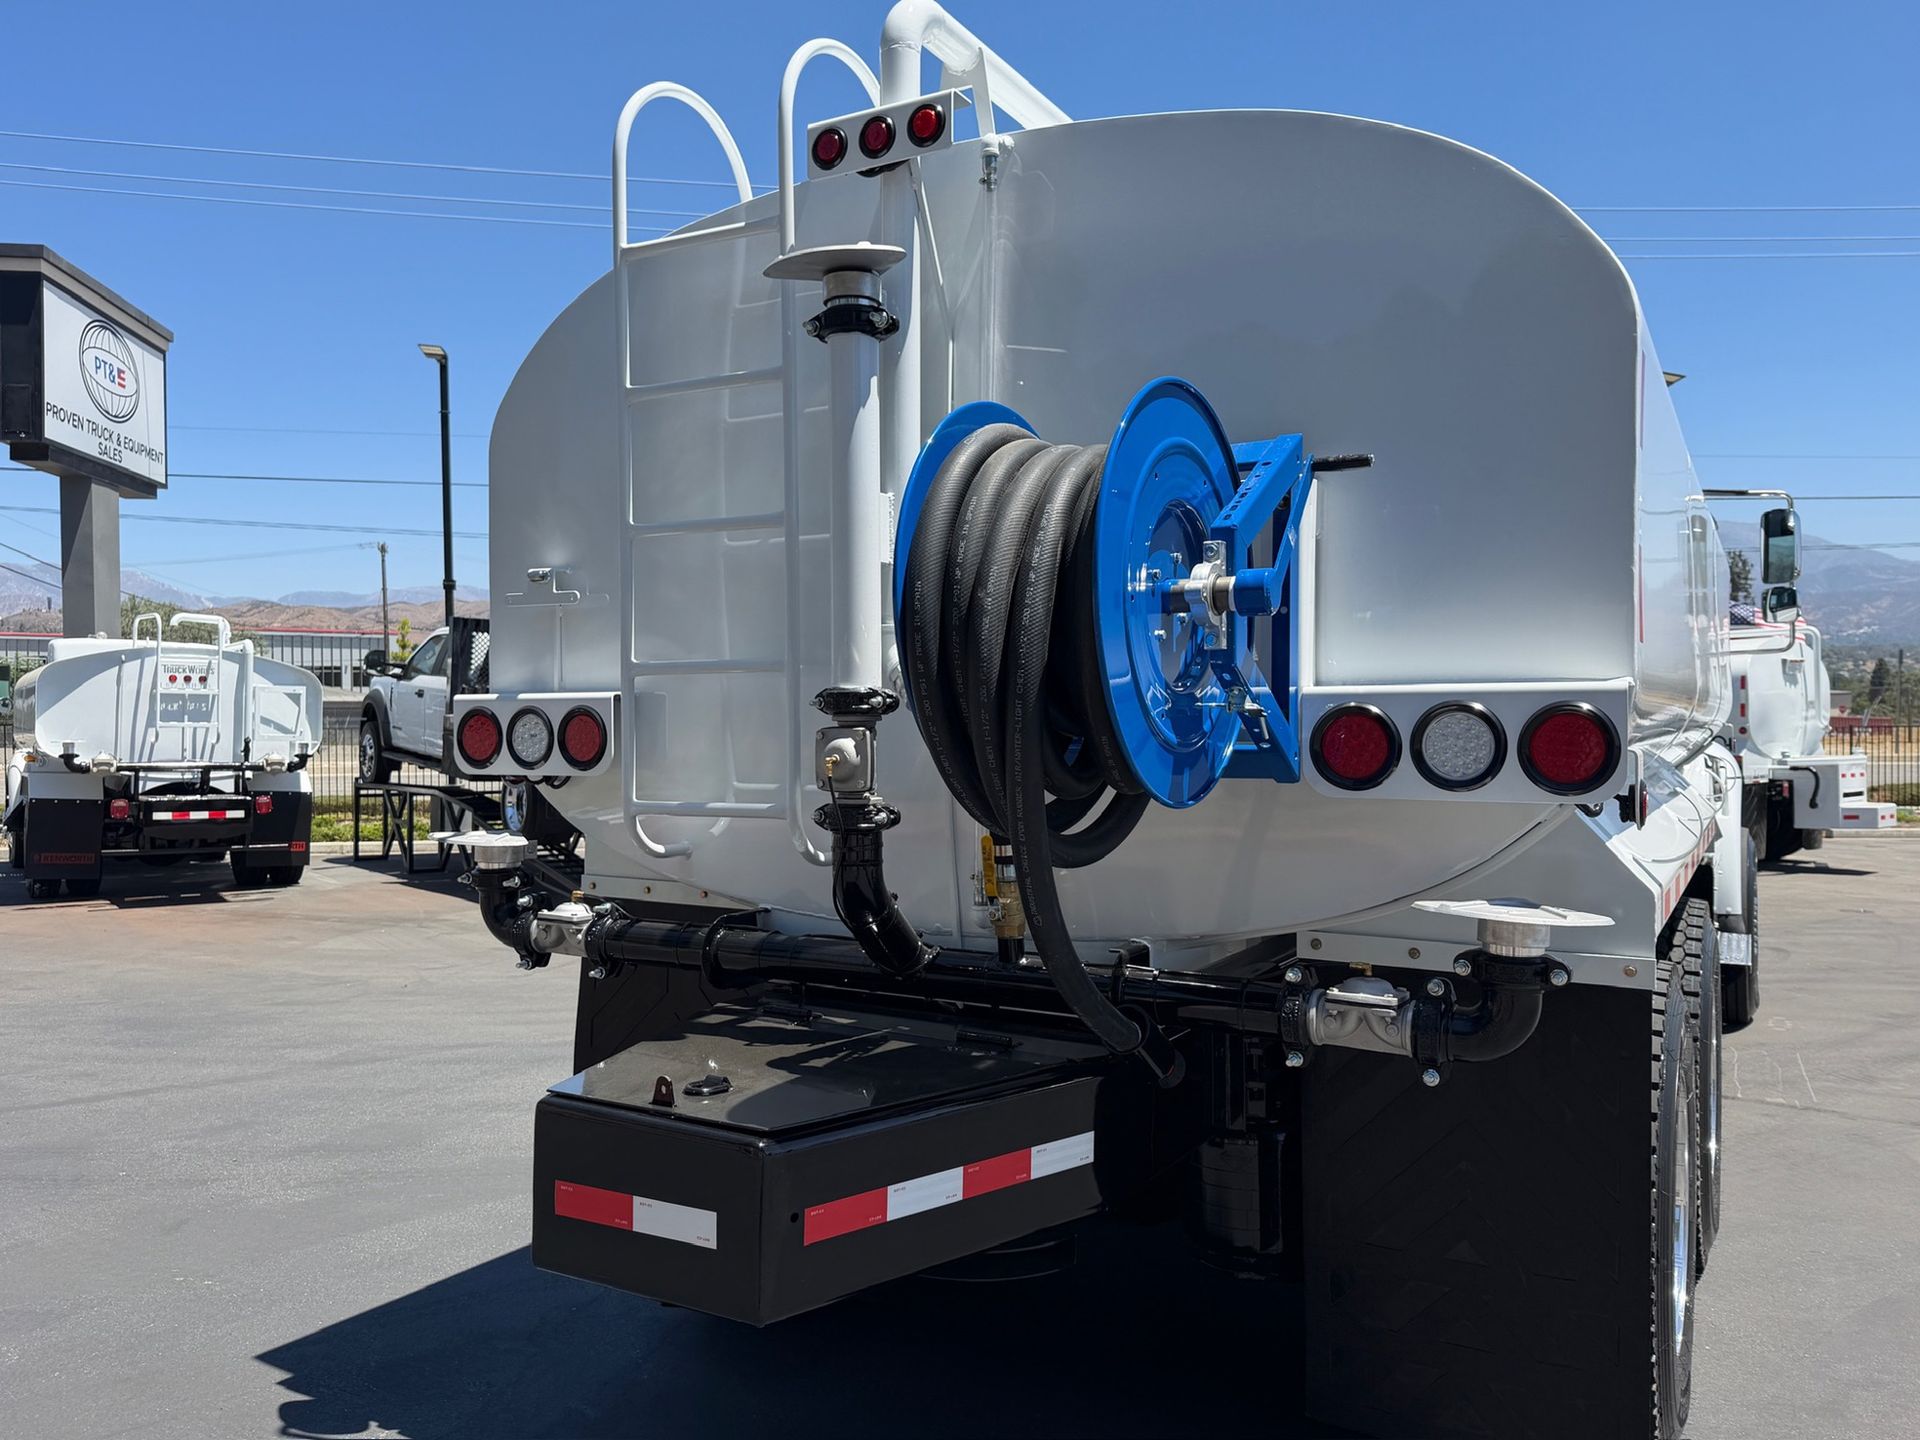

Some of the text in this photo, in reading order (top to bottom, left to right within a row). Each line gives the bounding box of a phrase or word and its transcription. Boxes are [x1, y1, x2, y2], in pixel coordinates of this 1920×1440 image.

[95, 355, 126, 389] PT&E
[46, 401, 164, 464] PROVEN TRUCK & EQUIPMENT
[98, 442, 123, 463] SALES
[914, 580, 922, 610] SPAIN
